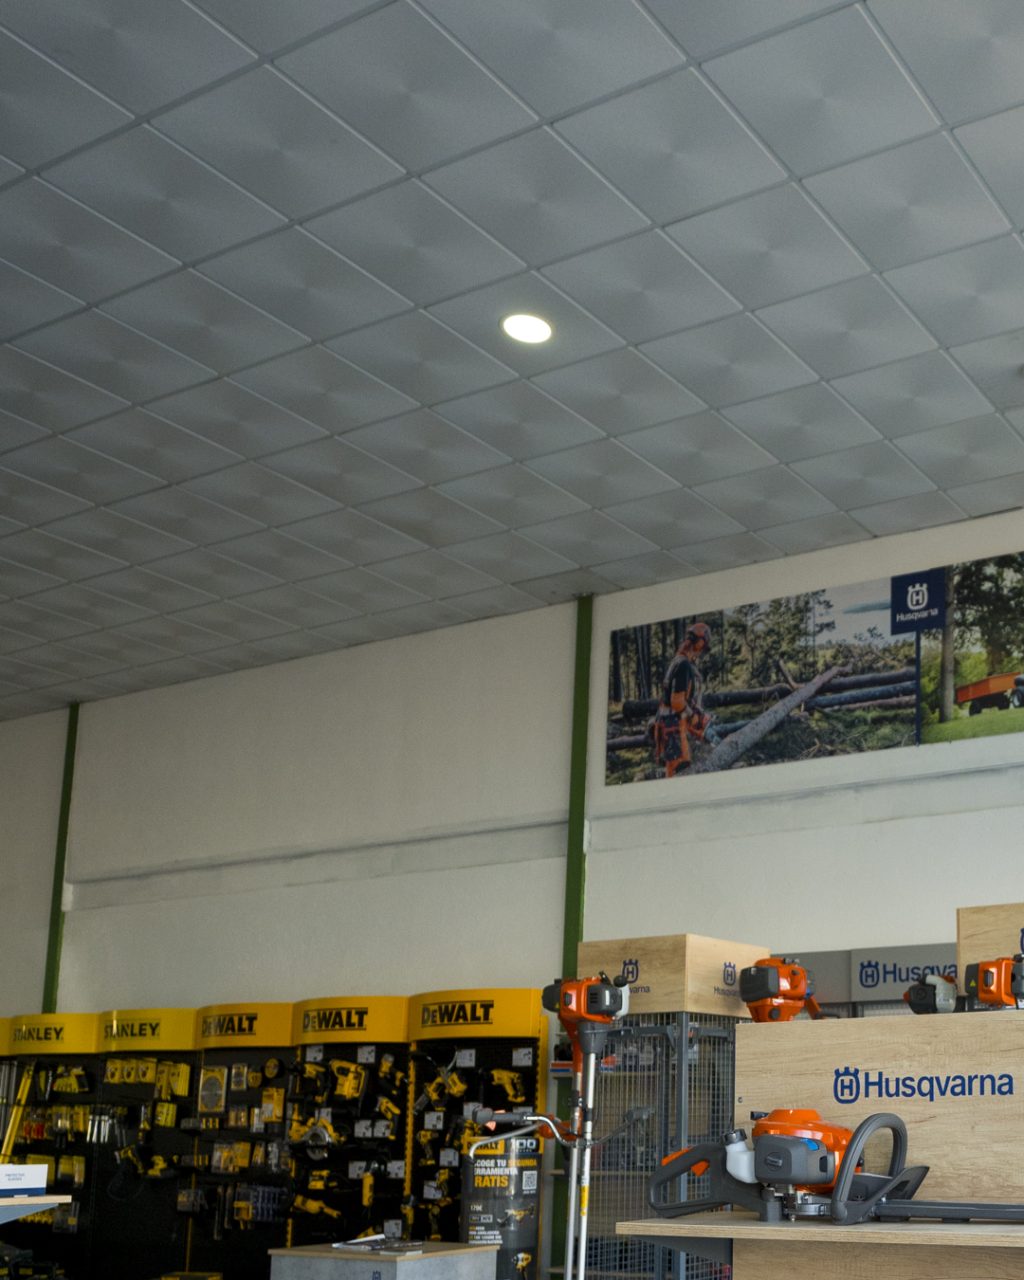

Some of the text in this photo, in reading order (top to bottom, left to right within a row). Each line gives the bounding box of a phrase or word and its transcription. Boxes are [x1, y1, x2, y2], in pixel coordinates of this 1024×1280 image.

[13, 1026, 64, 1041] STANLEY
[104, 1022, 159, 1039] STANLEY
[864, 1071, 1014, 1102] Husqvarna
[474, 1175, 509, 1188] RATIS
